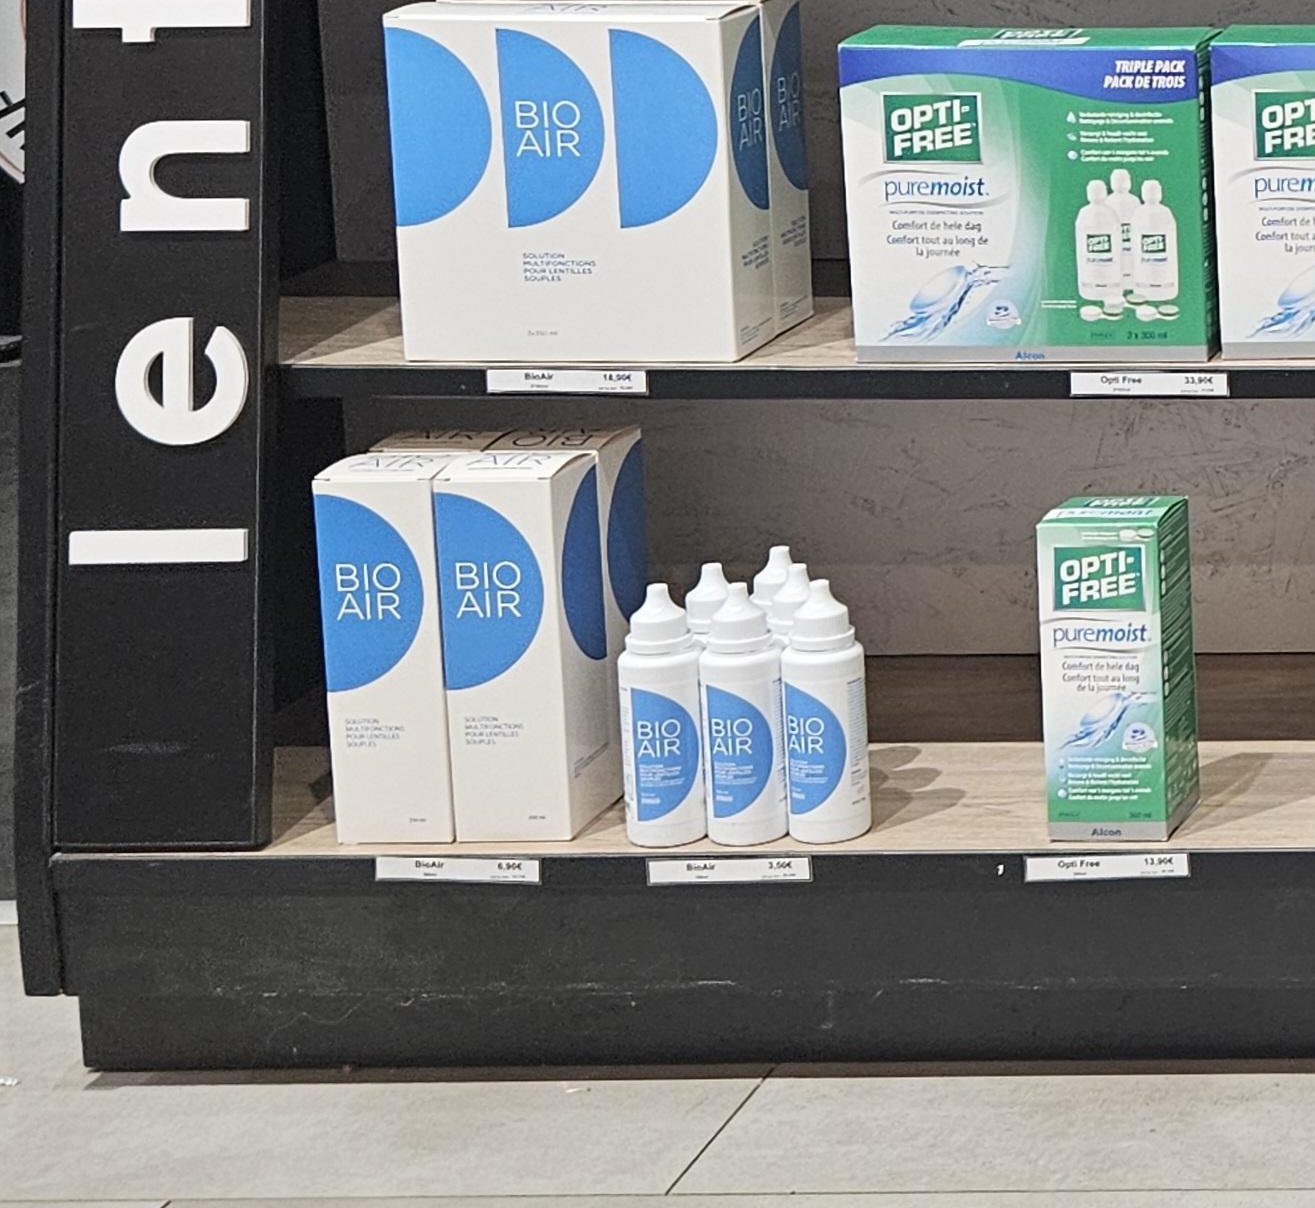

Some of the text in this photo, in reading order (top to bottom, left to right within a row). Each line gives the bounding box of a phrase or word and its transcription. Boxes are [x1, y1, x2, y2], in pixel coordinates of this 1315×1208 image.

[515, 101, 580, 128] BIO
[516, 130, 580, 157] AIR
[335, 563, 401, 591] BIO
[1059, 549, 1134, 582] OPTI-
[1062, 573, 1137, 604] FREE
[337, 592, 401, 620] AIR
[1053, 624, 1148, 648] puremoist
